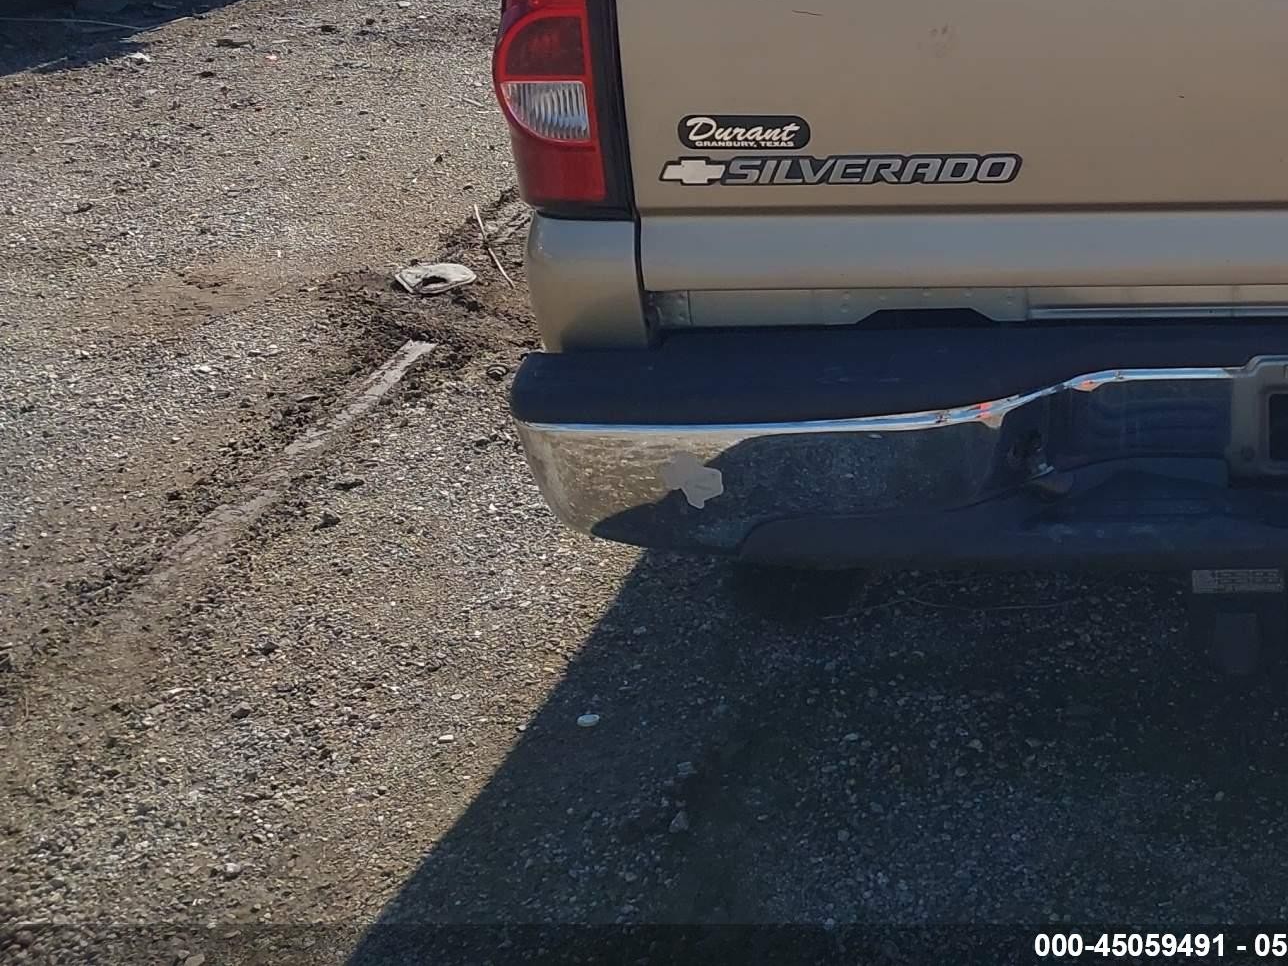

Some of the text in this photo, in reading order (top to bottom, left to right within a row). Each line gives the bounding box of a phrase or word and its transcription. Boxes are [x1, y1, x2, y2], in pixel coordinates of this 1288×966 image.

[685, 117, 800, 142] Durant
[694, 140, 795, 148] GRANBURY, TEXAS
[722, 155, 1018, 185] SILVERADO
